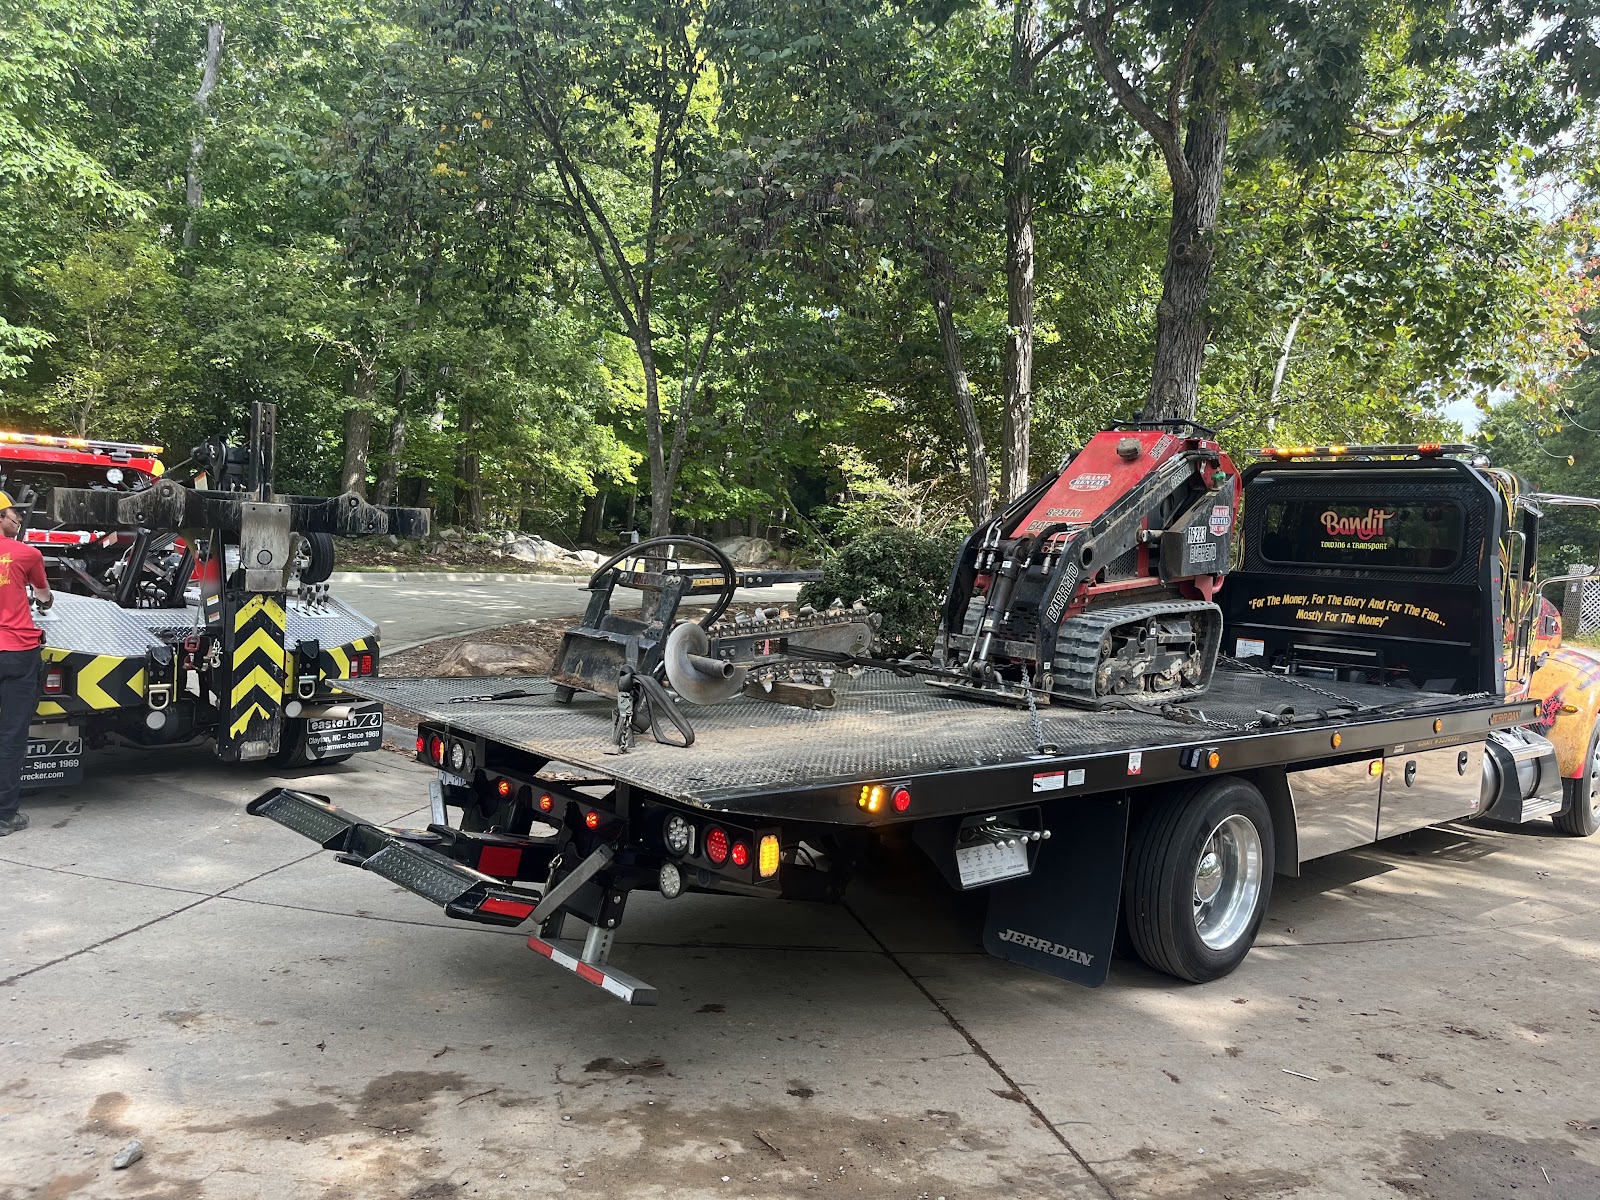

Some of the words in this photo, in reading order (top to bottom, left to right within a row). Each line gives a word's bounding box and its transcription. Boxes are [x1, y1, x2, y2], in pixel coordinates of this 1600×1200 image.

[1320, 508, 1396, 541] Bandit
[1320, 541, 1346, 549] TOWING
[1352, 542, 1388, 551] TRANSPORT
[1046, 561, 1079, 624] BARRETO
[1267, 595, 1281, 606] The
[1282, 594, 1310, 606] Money,
[1311, 594, 1326, 605] For
[1327, 594, 1343, 606] The
[1343, 595, 1367, 609] Glory
[1367, 598, 1386, 610] And
[1386, 600, 1402, 613] For
[1404, 603, 1421, 617] The
[1421, 607, 1446, 627] Fun...
[1296, 609, 1323, 623] Mostly
[1324, 611, 1339, 622] For
[1340, 612, 1357, 624] The
[311, 718, 358, 731] eastern
[308, 736, 331, 745] Clayton,
[332, 733, 342, 742] NC
[347, 732, 364, 740] Since
[365, 730, 380, 738] 1969
[33, 761, 57, 770] Since
[59, 758, 79, 768] 1969
[998, 928, 1095, 967] JERR-DAN
